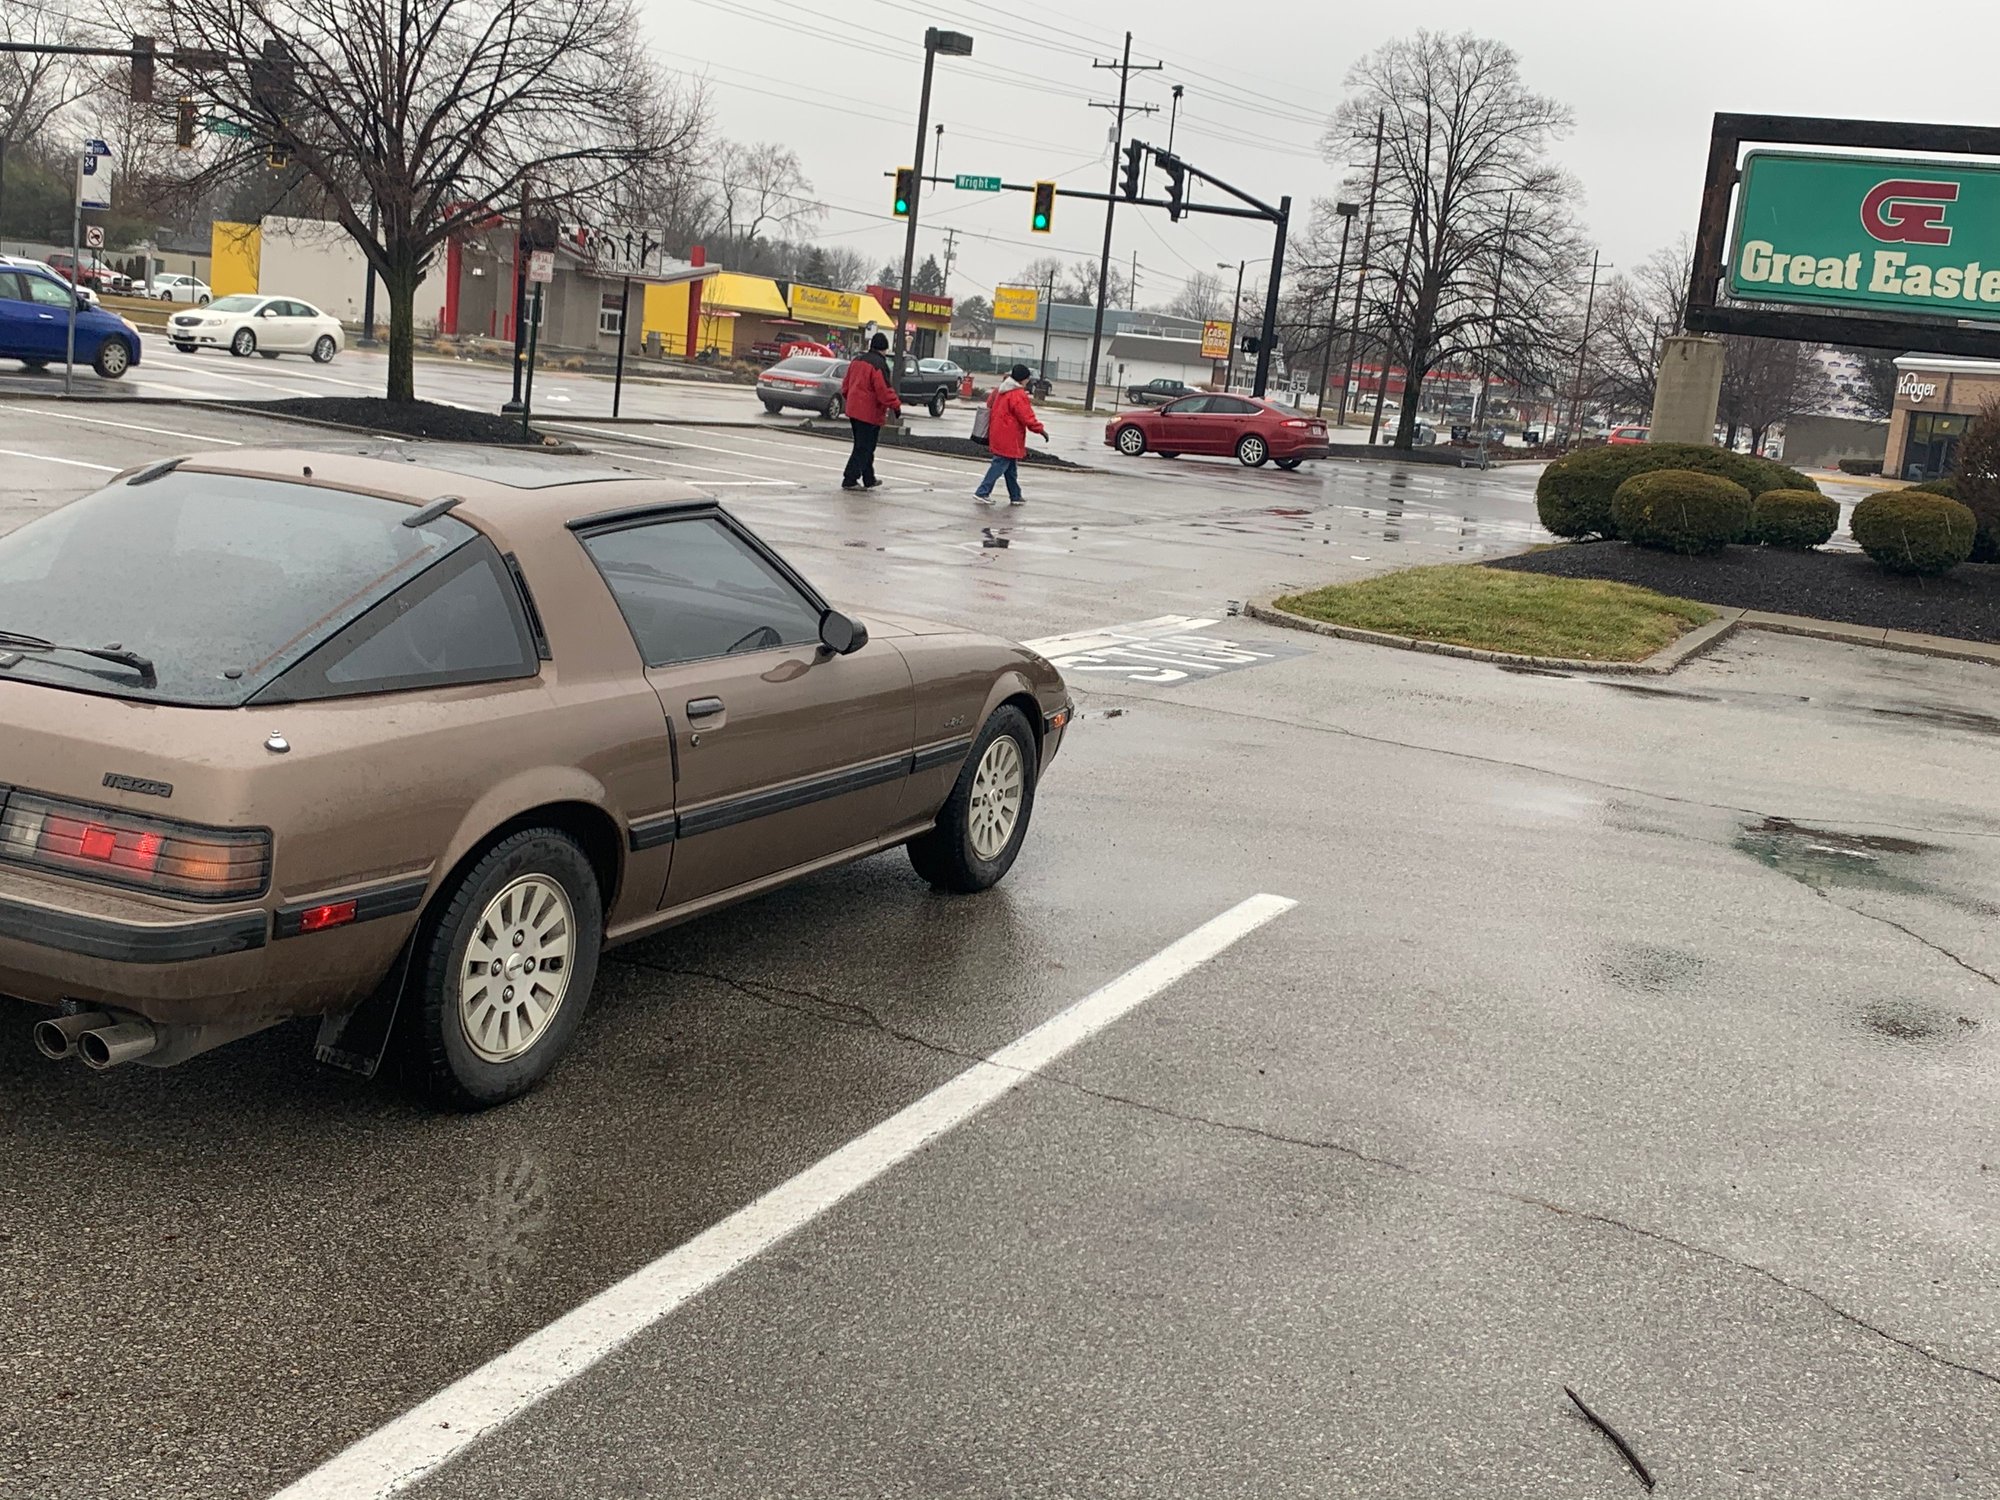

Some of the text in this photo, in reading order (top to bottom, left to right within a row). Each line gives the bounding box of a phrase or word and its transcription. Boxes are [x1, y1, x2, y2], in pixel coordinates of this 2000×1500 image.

[84, 156, 94, 167] 24
[959, 176, 989, 190] Wright
[1860, 178, 1960, 246] GE
[1740, 240, 2000, 302] Great Easte
[1208, 328, 1226, 338] CASH
[1204, 338, 1228, 347] LOANS
[1291, 381, 1306, 391] 35
[1898, 372, 1936, 402] Kroger
